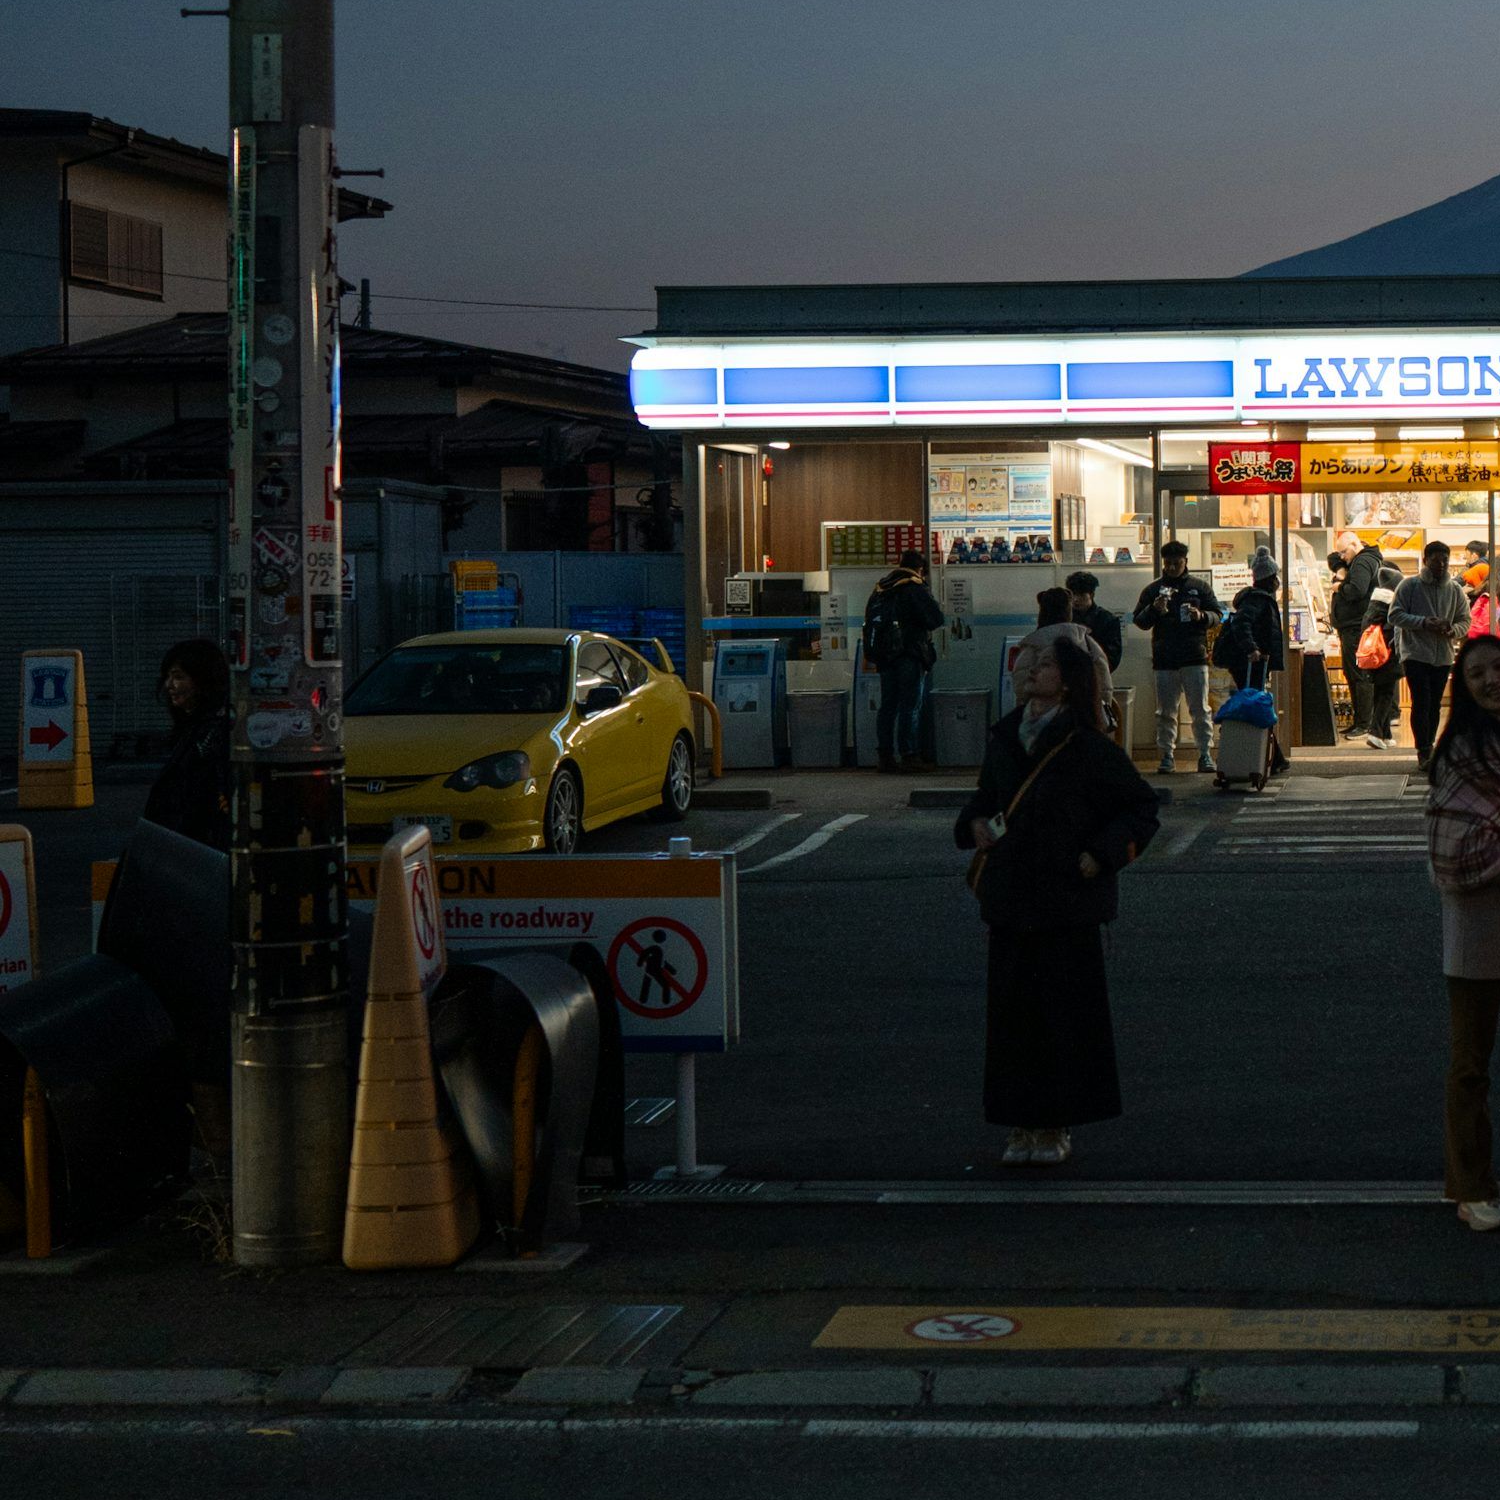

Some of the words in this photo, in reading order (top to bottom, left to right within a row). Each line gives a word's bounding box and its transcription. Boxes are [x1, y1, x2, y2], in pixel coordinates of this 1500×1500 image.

[1241, 450, 1272, 465] 関東
[1309, 457, 1406, 475] からあげクン
[1215, 458, 1295, 483] うまいもん祭
[444, 906, 483, 928] the
[489, 906, 594, 933] roadway
